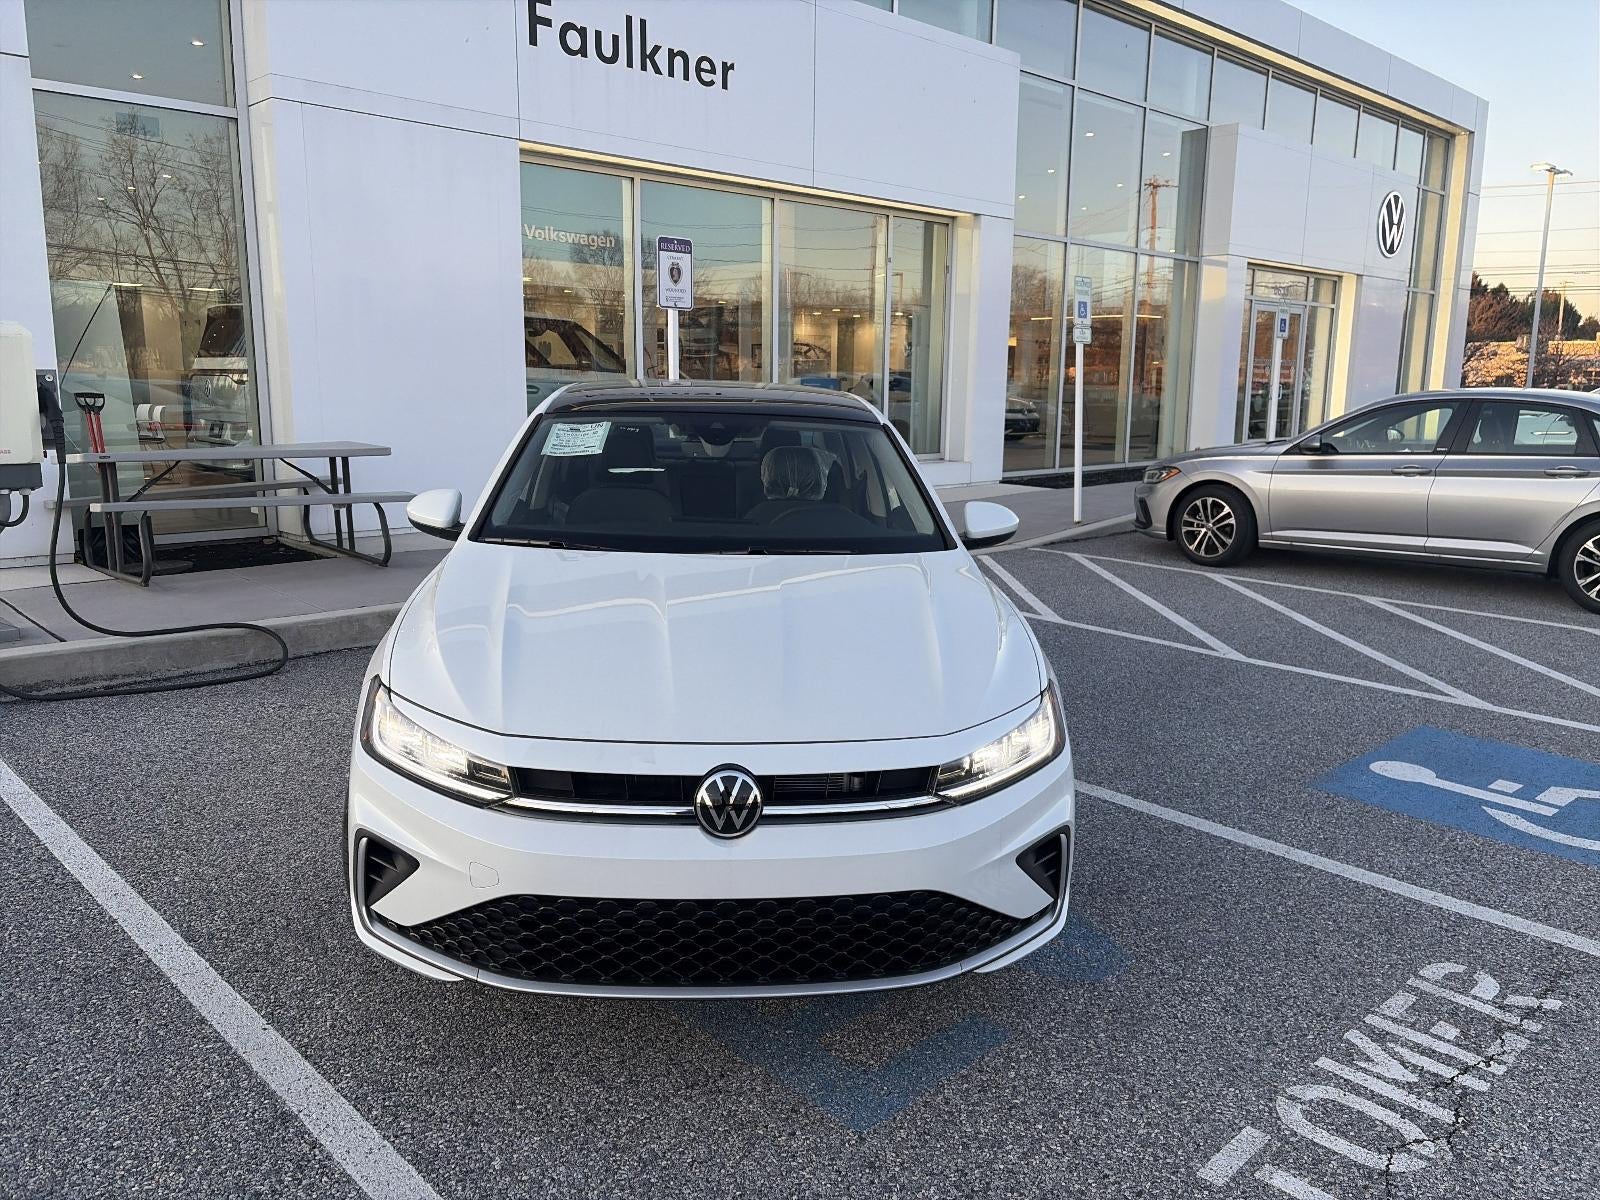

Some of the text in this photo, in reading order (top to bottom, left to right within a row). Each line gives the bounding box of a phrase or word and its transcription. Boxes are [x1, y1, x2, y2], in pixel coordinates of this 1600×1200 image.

[528, 0, 735, 90] Faulkner
[523, 224, 615, 249] Volkswagen
[660, 242, 691, 252] RESERVED
